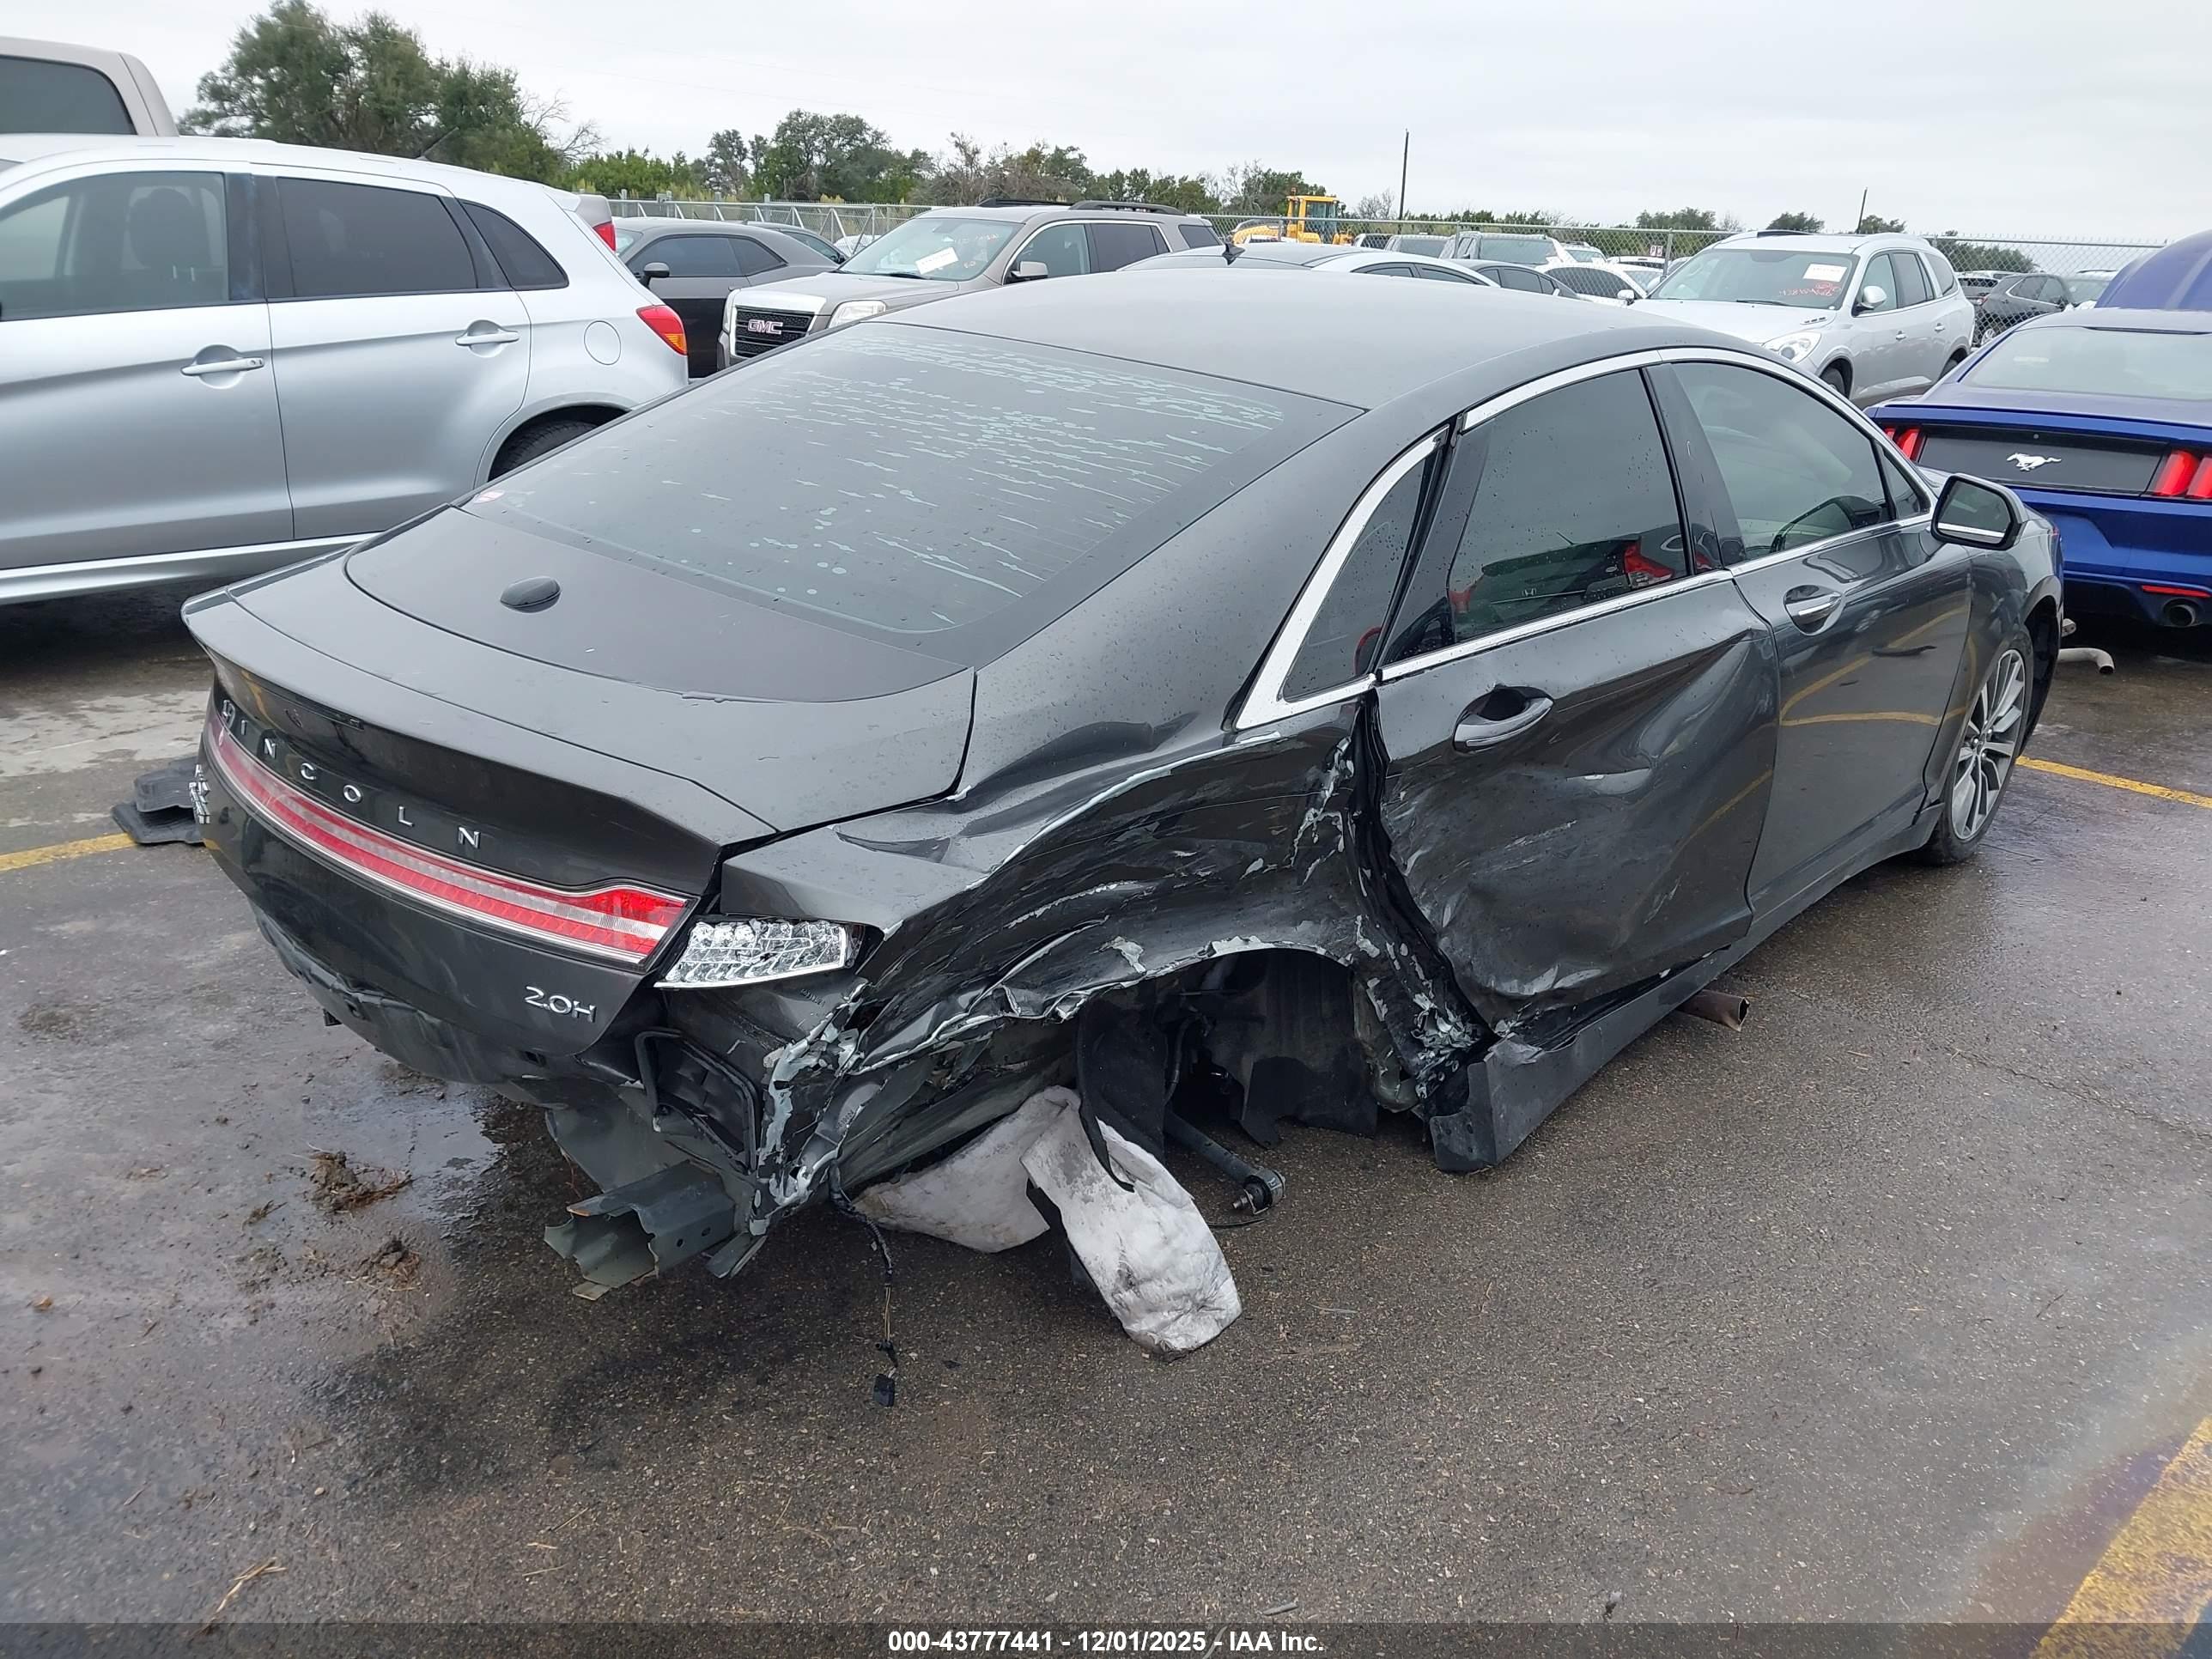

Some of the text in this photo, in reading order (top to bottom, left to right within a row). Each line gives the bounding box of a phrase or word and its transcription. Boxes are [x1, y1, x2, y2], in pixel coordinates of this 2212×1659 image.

[747, 319, 783, 335] GMC
[222, 699, 482, 849] LINCOLN
[524, 985, 596, 1023] 2.0H
